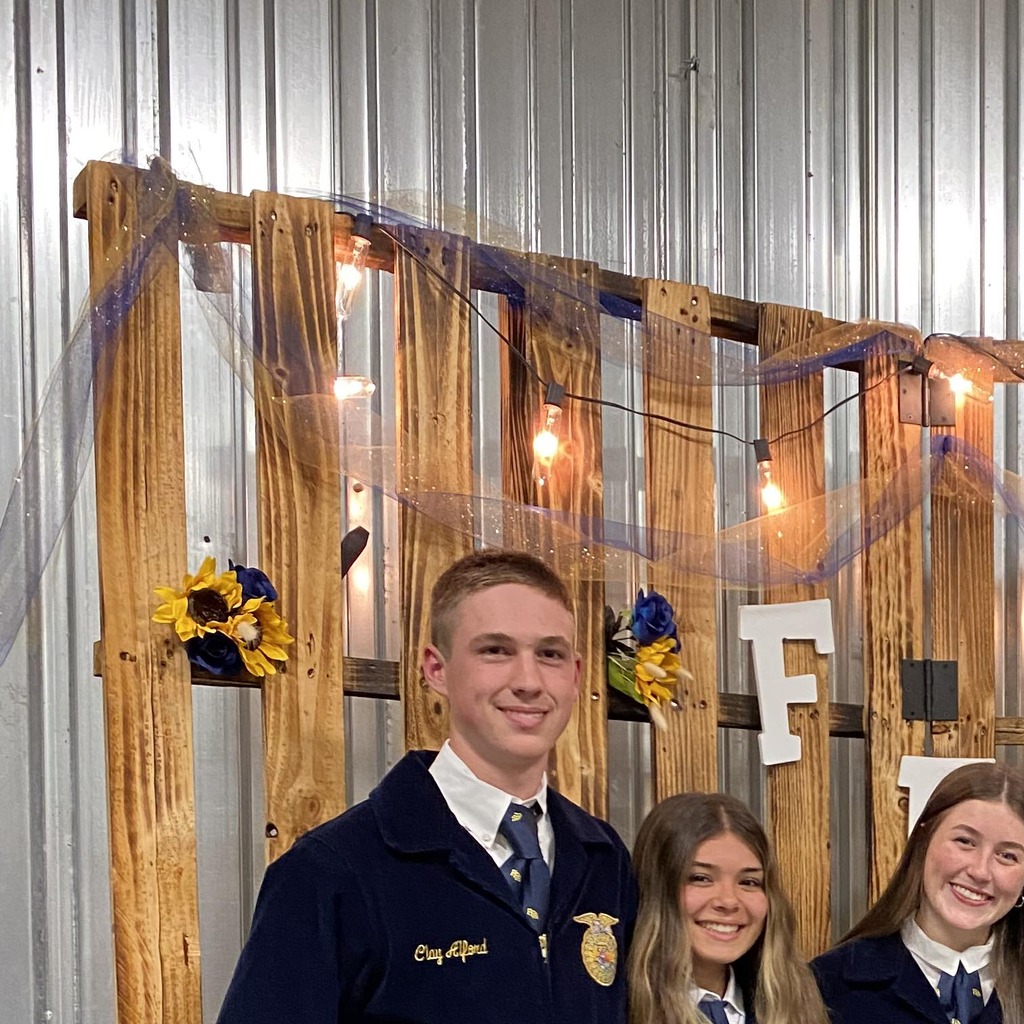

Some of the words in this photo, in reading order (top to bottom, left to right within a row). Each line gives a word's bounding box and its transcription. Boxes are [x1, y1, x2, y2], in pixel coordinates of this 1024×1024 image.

[739, 598, 835, 766] F
[414, 944, 444, 965] Clay
[445, 937, 489, 963] Alford
